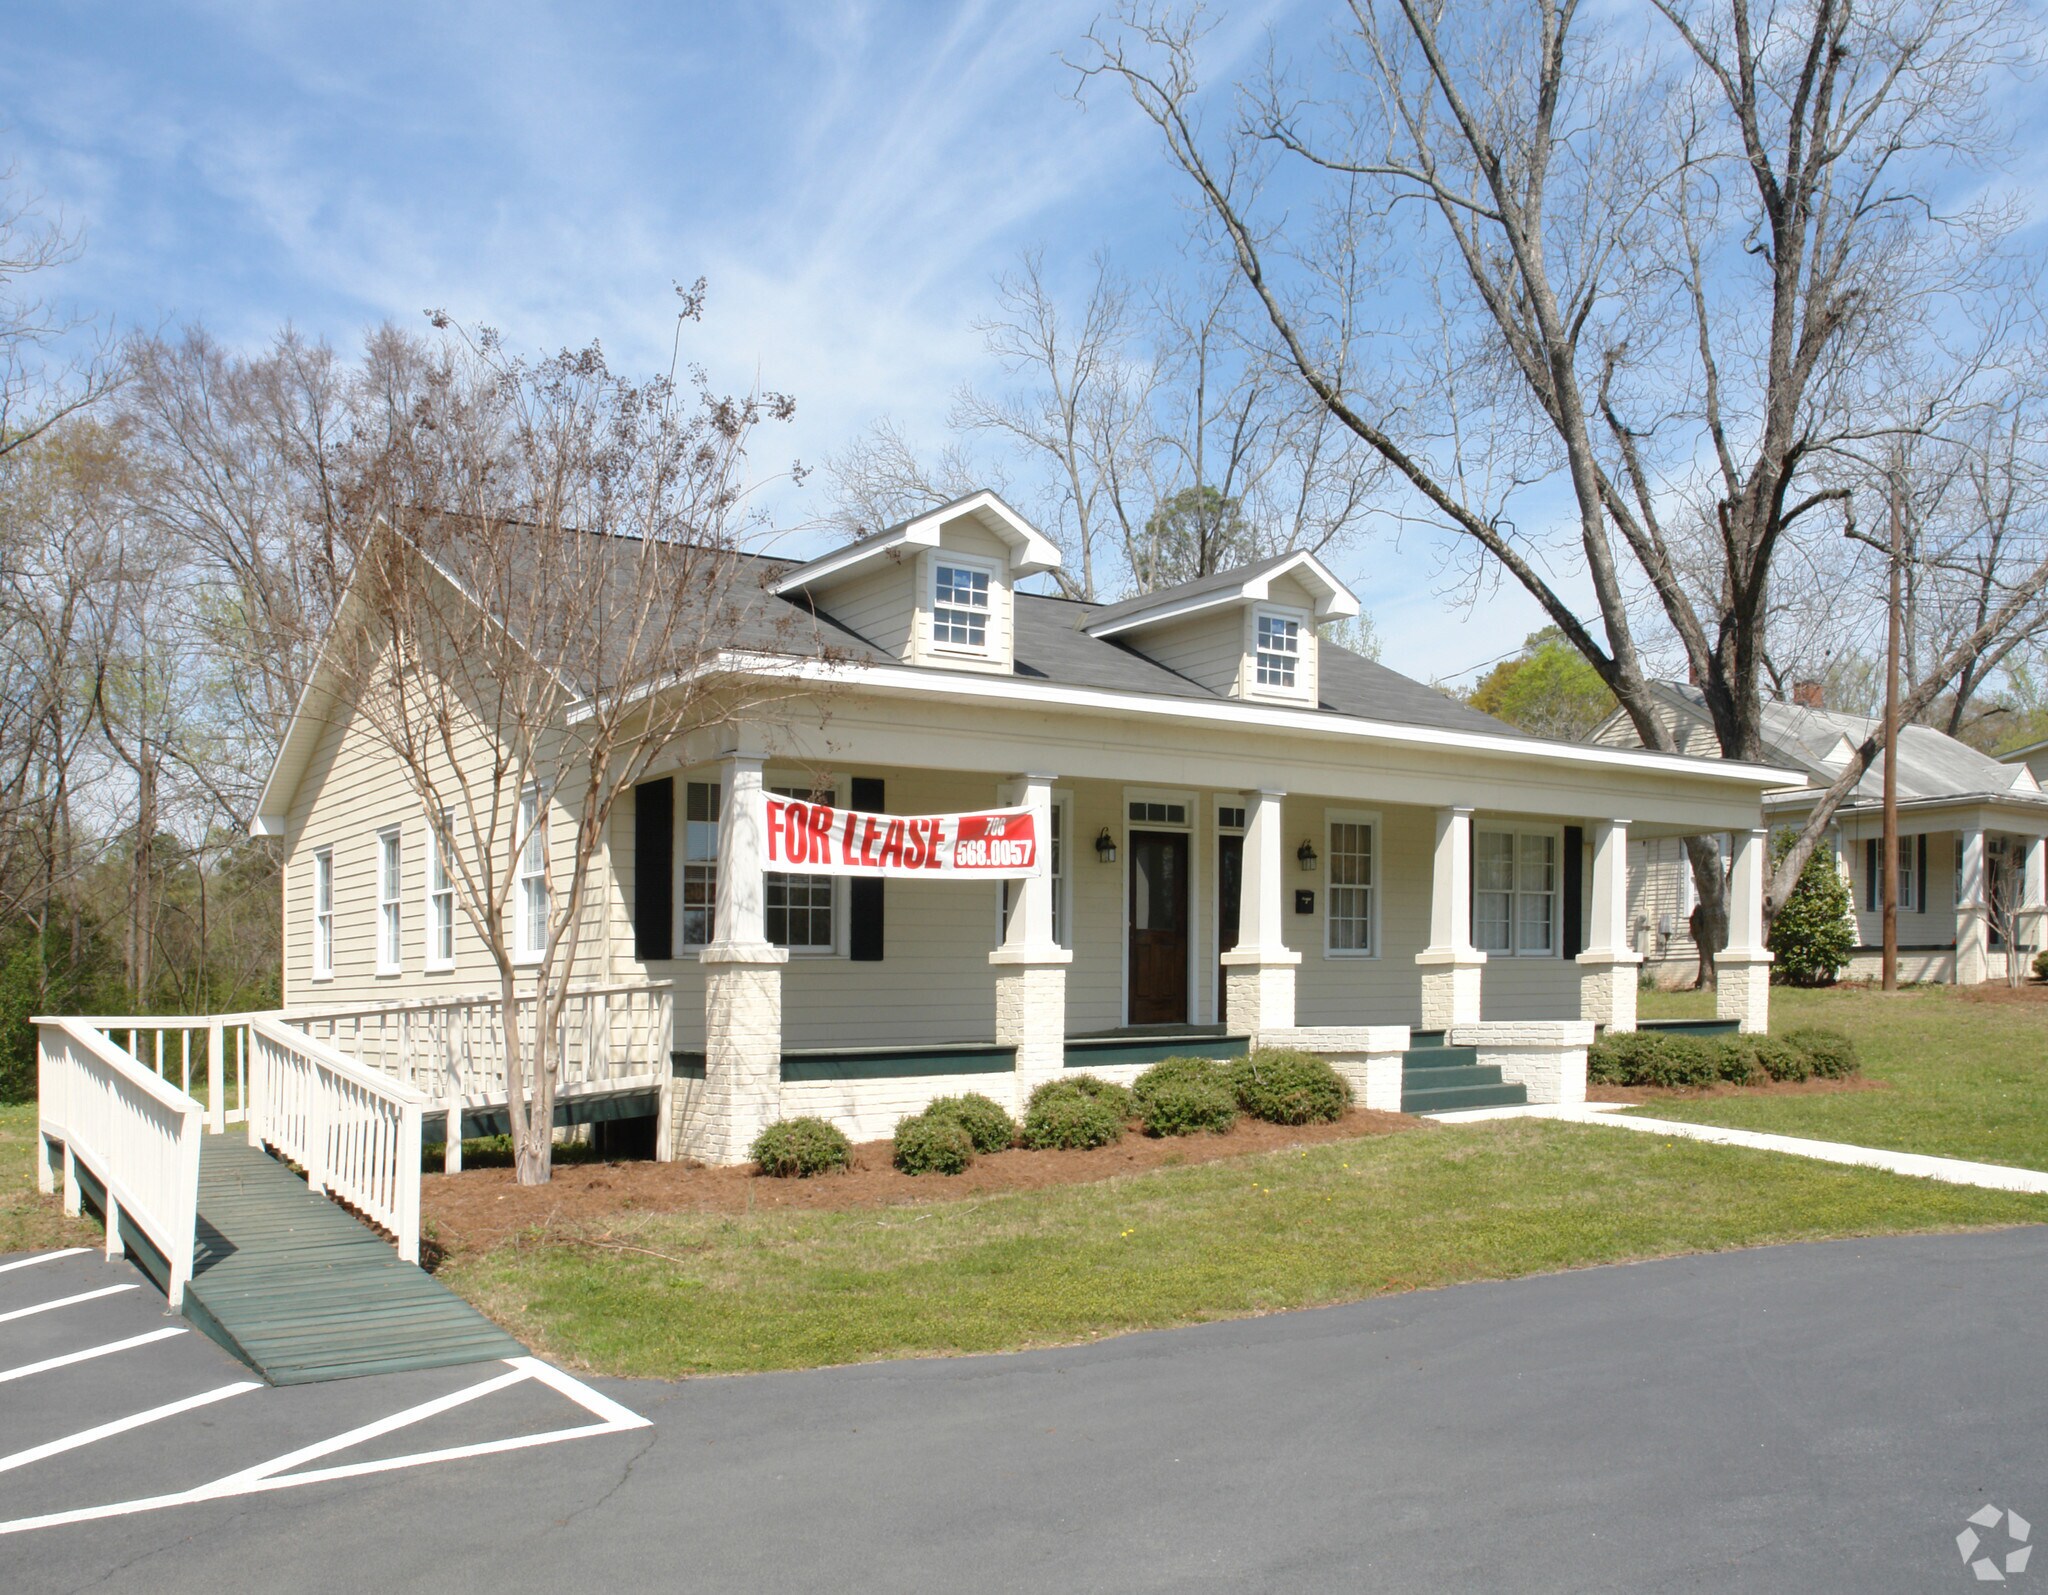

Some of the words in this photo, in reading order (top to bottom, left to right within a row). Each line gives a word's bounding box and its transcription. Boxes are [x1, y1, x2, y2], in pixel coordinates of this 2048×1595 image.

[766, 800, 834, 864] FOR
[842, 812, 945, 869] LEASE
[956, 840, 1032, 866] 568.0057
